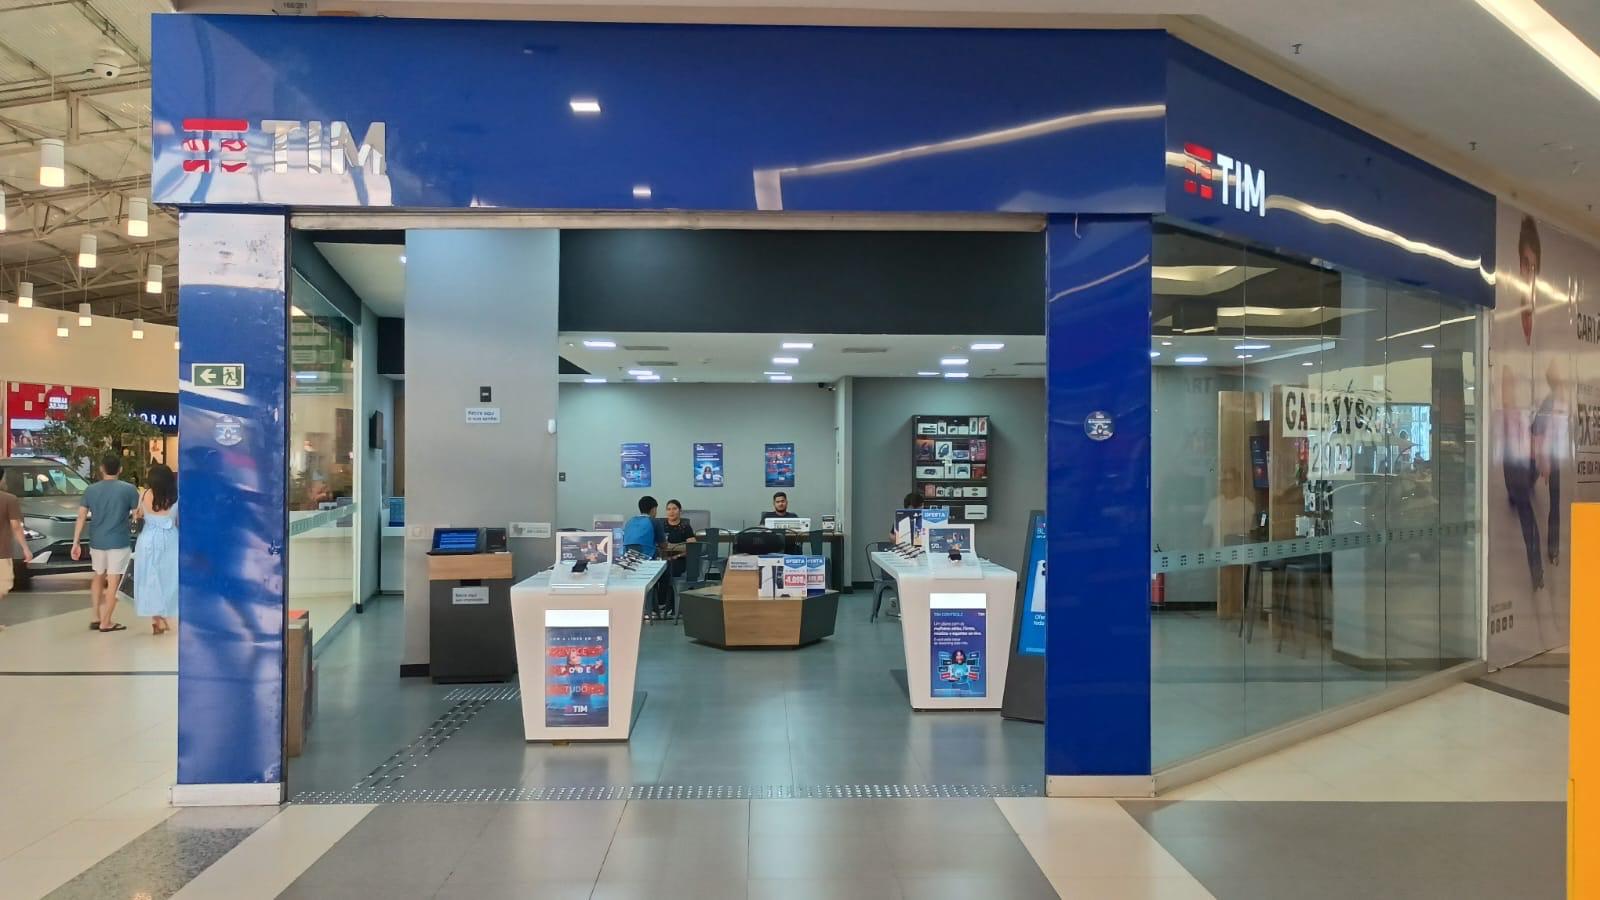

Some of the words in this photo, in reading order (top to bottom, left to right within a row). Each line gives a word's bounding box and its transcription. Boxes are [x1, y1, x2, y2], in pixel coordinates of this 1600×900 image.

[261, 119, 386, 175] TIM
[1217, 152, 1266, 217] TIM
[128, 412, 177, 426] ORAN
[573, 705, 588, 713] TIM
